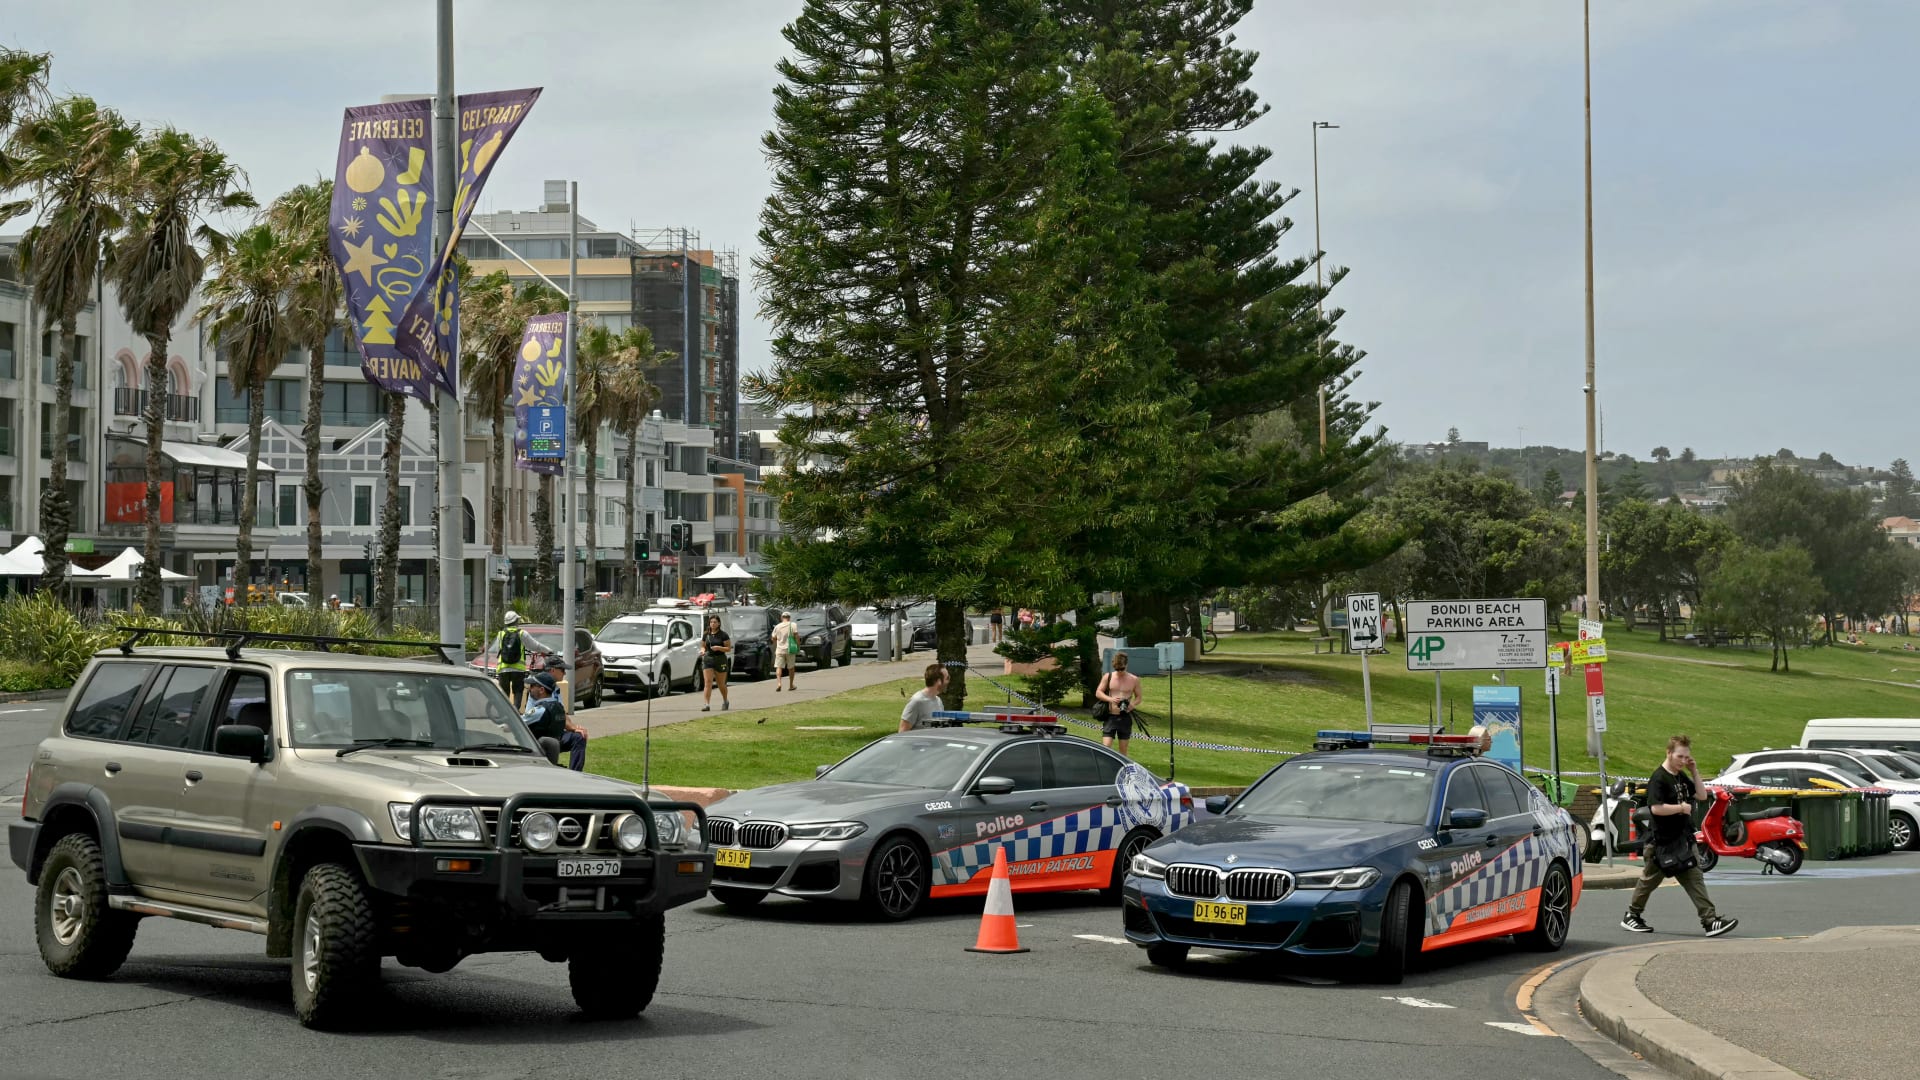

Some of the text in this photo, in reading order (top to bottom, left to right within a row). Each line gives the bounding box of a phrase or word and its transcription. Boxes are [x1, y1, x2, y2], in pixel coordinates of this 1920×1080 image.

[542, 422, 551, 432] P
[1352, 599, 1375, 612] ONE
[1431, 603, 1521, 615] BONDI BEACH
[1352, 616, 1377, 629] WAY
[1427, 616, 1525, 628] PARKING AREA
[1408, 635, 1446, 661] 4P
[924, 801, 953, 811] CE202
[975, 814, 1024, 837] Police
[1417, 838, 1438, 850] CE213
[1045, 855, 1095, 873] PATROL
[1450, 850, 1482, 879] Police
[1213, 905, 1227, 919] 96
[1230, 906, 1244, 920] GR
